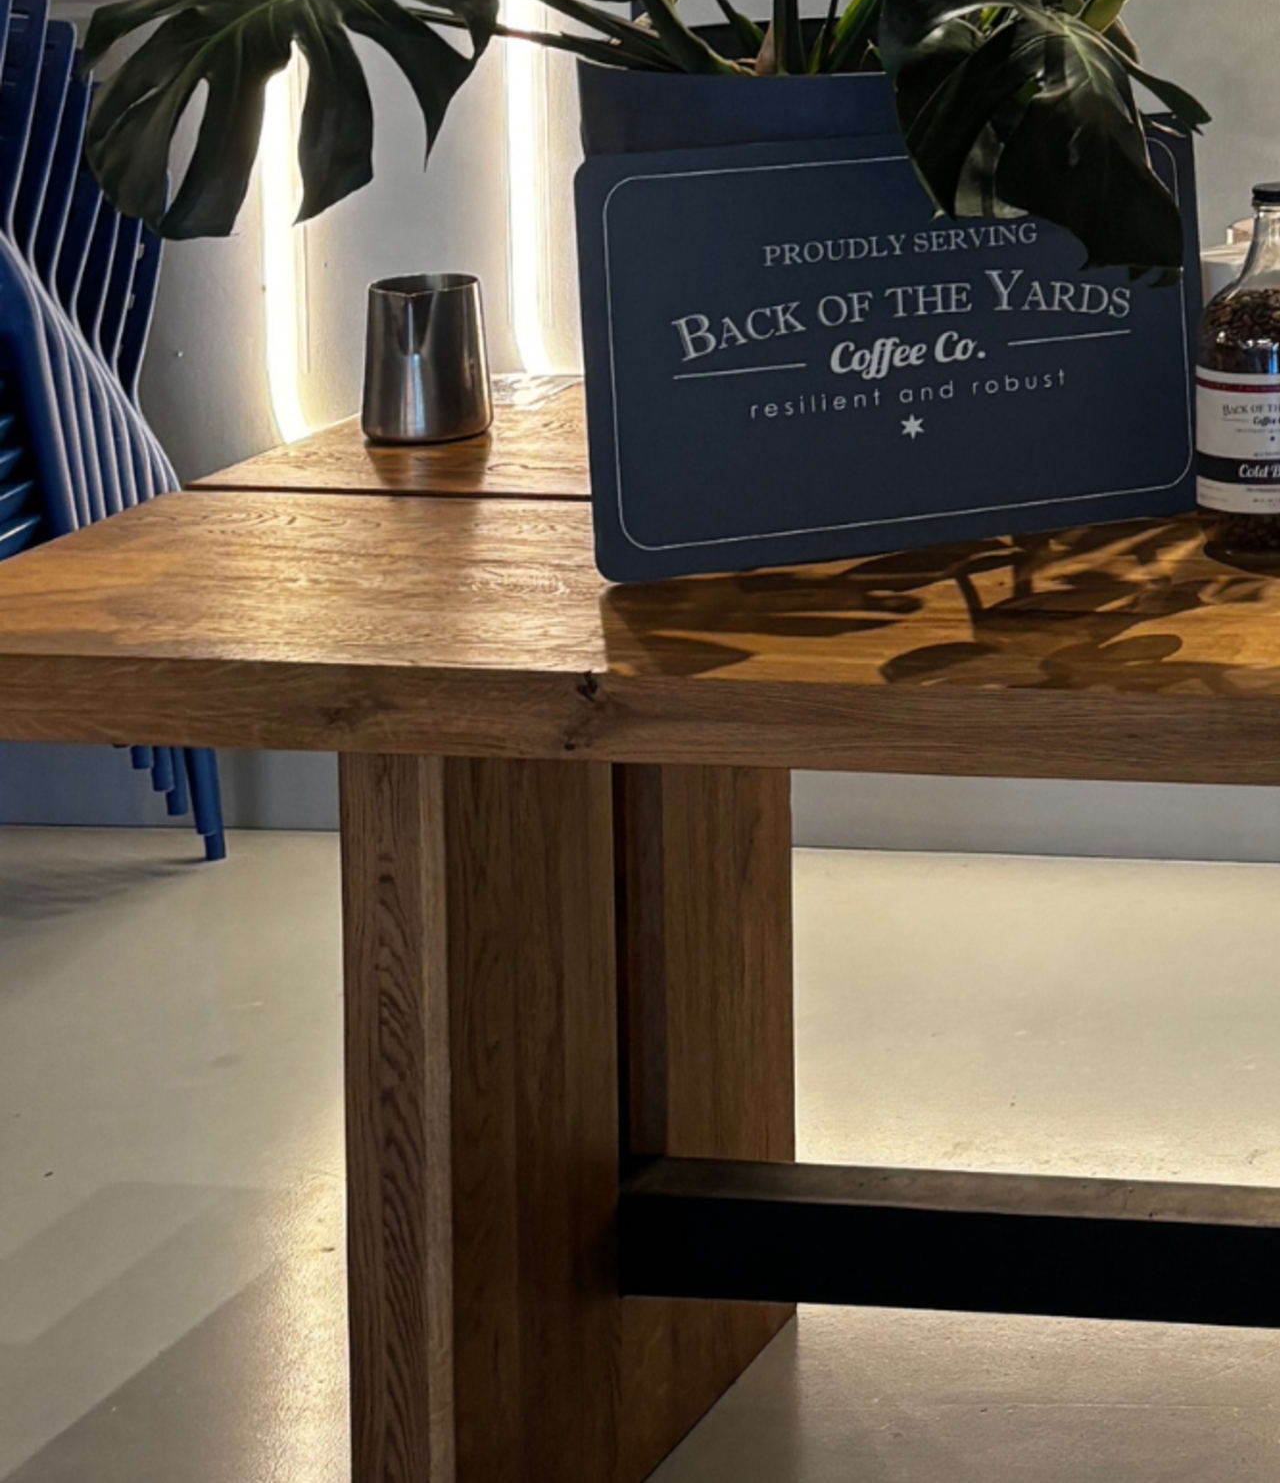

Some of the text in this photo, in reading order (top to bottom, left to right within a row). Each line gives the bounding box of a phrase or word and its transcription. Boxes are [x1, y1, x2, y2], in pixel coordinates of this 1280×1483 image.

[762, 222, 1039, 267] PROUDLY SERVING
[829, 330, 986, 380] Coffee Co.
[750, 368, 1068, 419] resilient and robust
[1238, 463, 1268, 478] Cold
